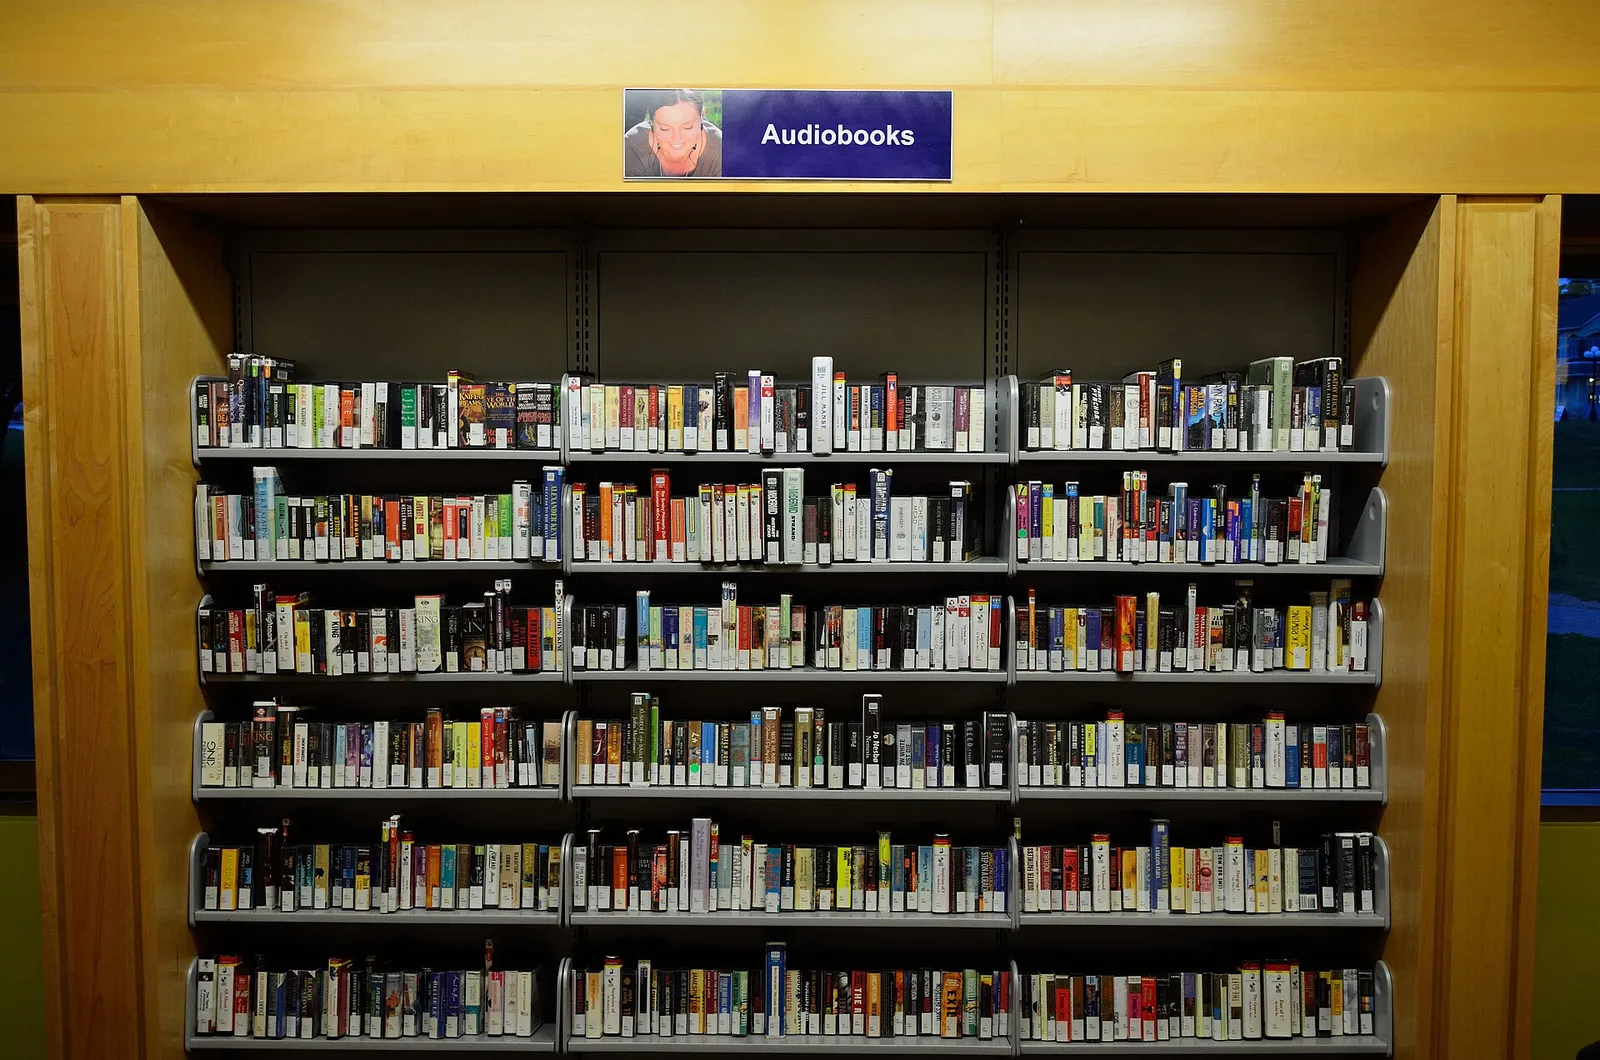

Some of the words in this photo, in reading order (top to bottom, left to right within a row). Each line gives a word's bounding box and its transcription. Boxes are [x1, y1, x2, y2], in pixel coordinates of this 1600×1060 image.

[761, 123, 915, 146] Audiobooks
[486, 428, 514, 437] Rort
[331, 621, 340, 639] KING
[872, 730, 880, 739] Jo
[206, 740, 216, 766] KING
[854, 988, 862, 1005] THE
